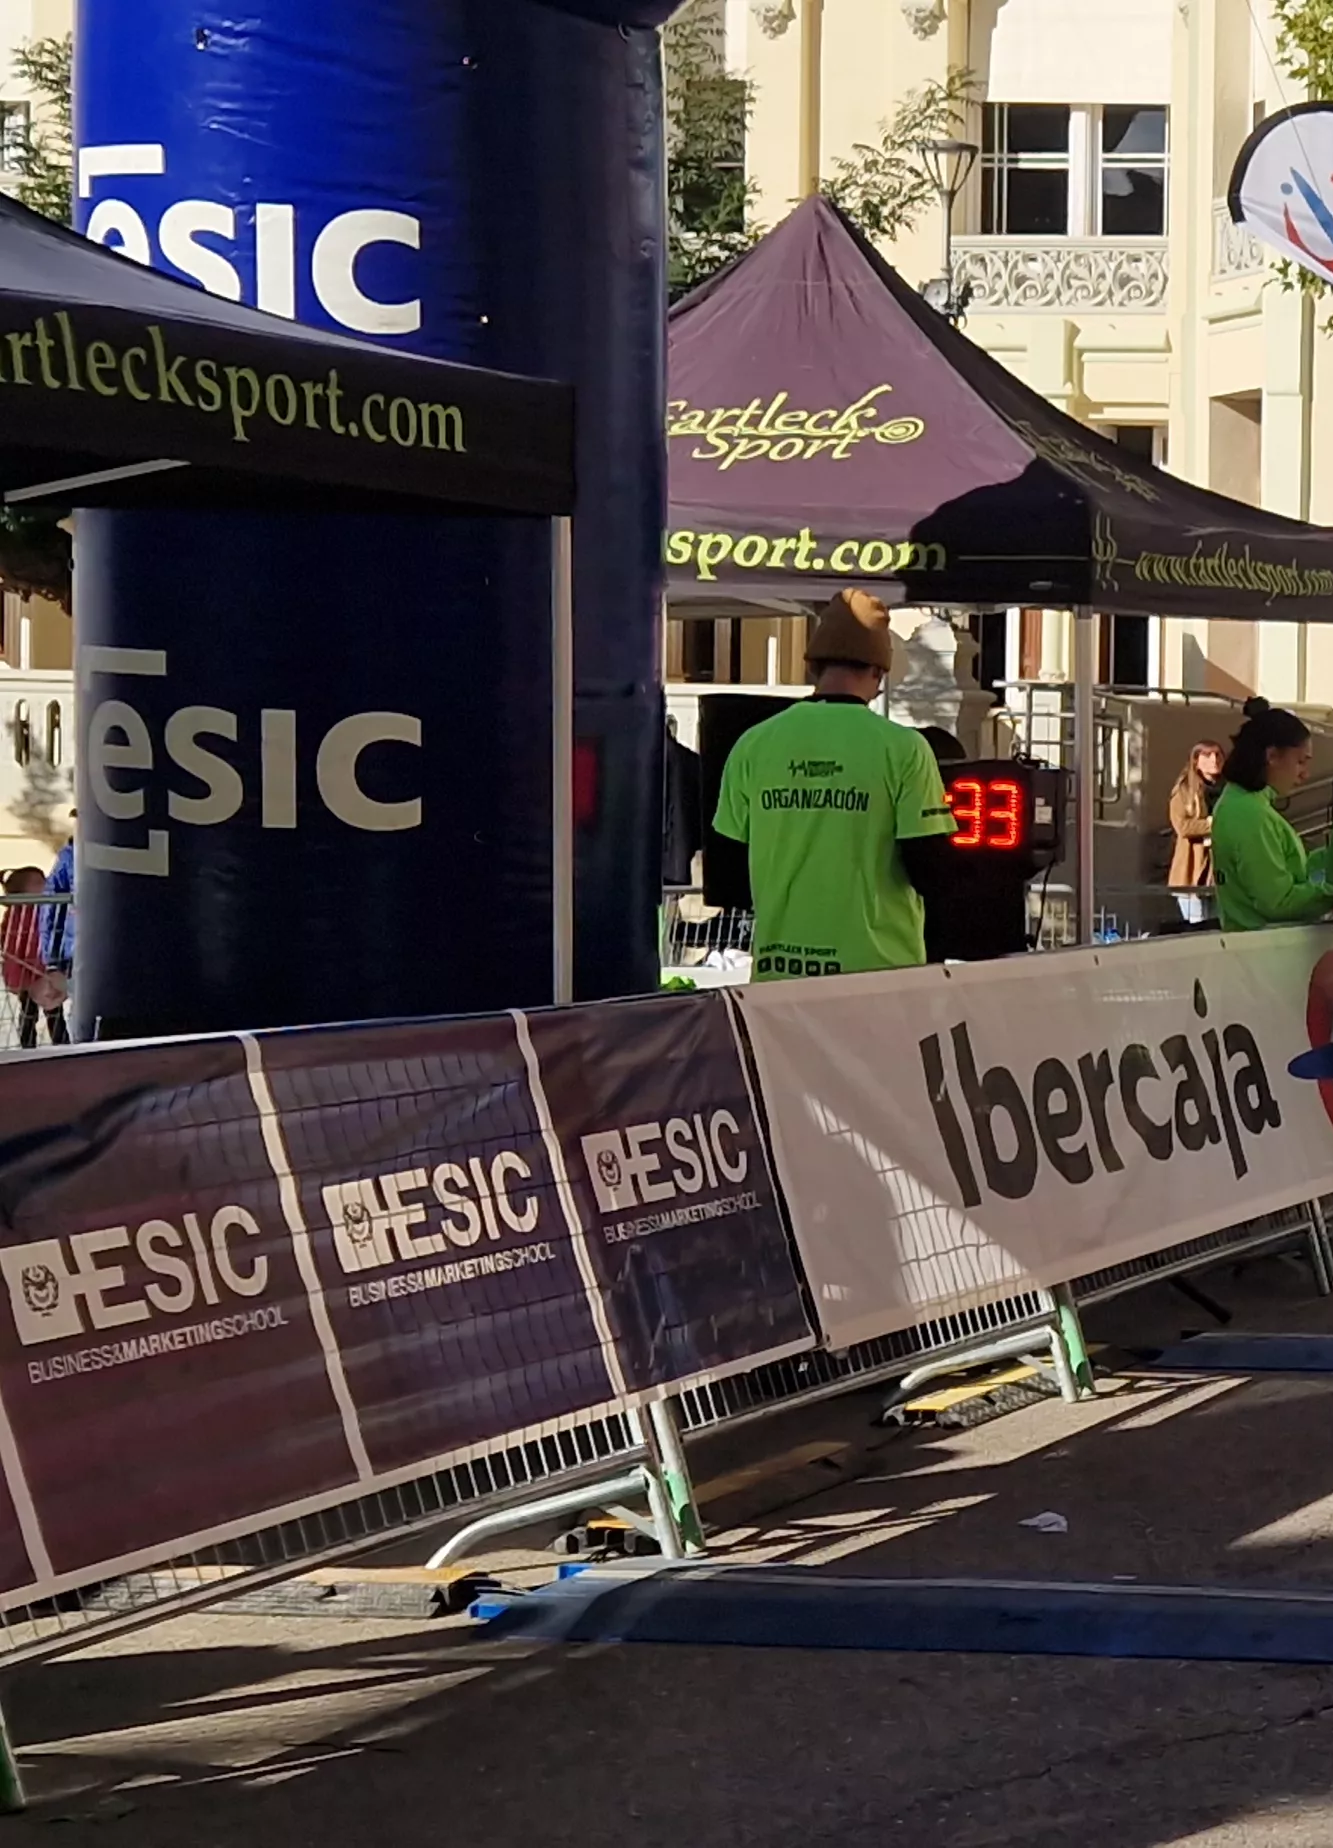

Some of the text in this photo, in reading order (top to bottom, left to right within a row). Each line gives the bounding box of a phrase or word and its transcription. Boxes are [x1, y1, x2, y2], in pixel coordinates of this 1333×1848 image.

[0, 310, 468, 453] rtlecksport.com
[691, 424, 861, 471] Sport
[919, 977, 1281, 1208] Ibercaja
[378, 1150, 539, 1261] ESIC
[625, 1108, 748, 1204] ESIC
[69, 1204, 268, 1330] ESIC
